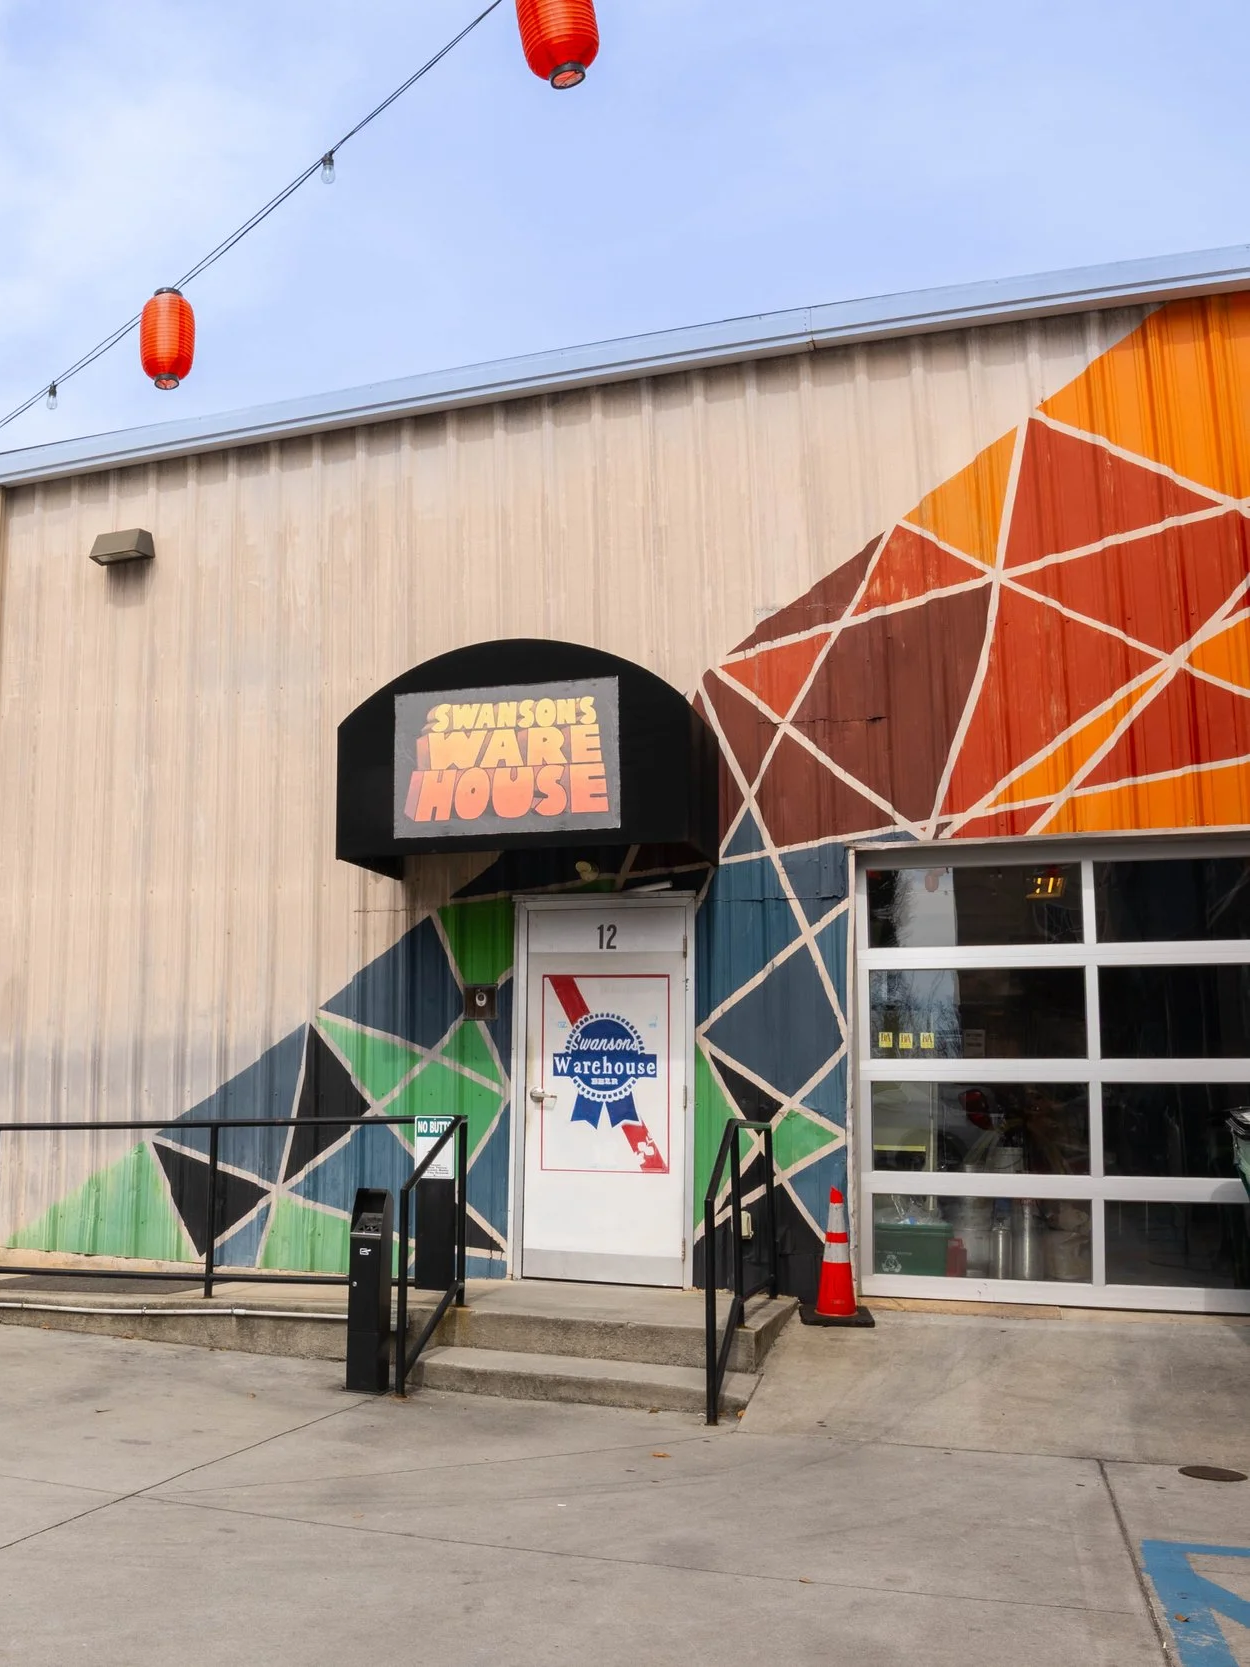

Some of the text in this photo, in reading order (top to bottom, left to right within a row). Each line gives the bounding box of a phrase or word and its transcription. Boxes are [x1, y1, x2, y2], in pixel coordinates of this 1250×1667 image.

[423, 696, 597, 733] SWANSON'S
[418, 724, 603, 771] WARE
[406, 762, 609, 822] HOUSE
[597, 924, 618, 950] 12
[570, 1032, 640, 1051] Swansons
[554, 1055, 656, 1075] Warehouse
[591, 1077, 618, 1085] BEER
[417, 1121, 451, 1133] NO BUTT
